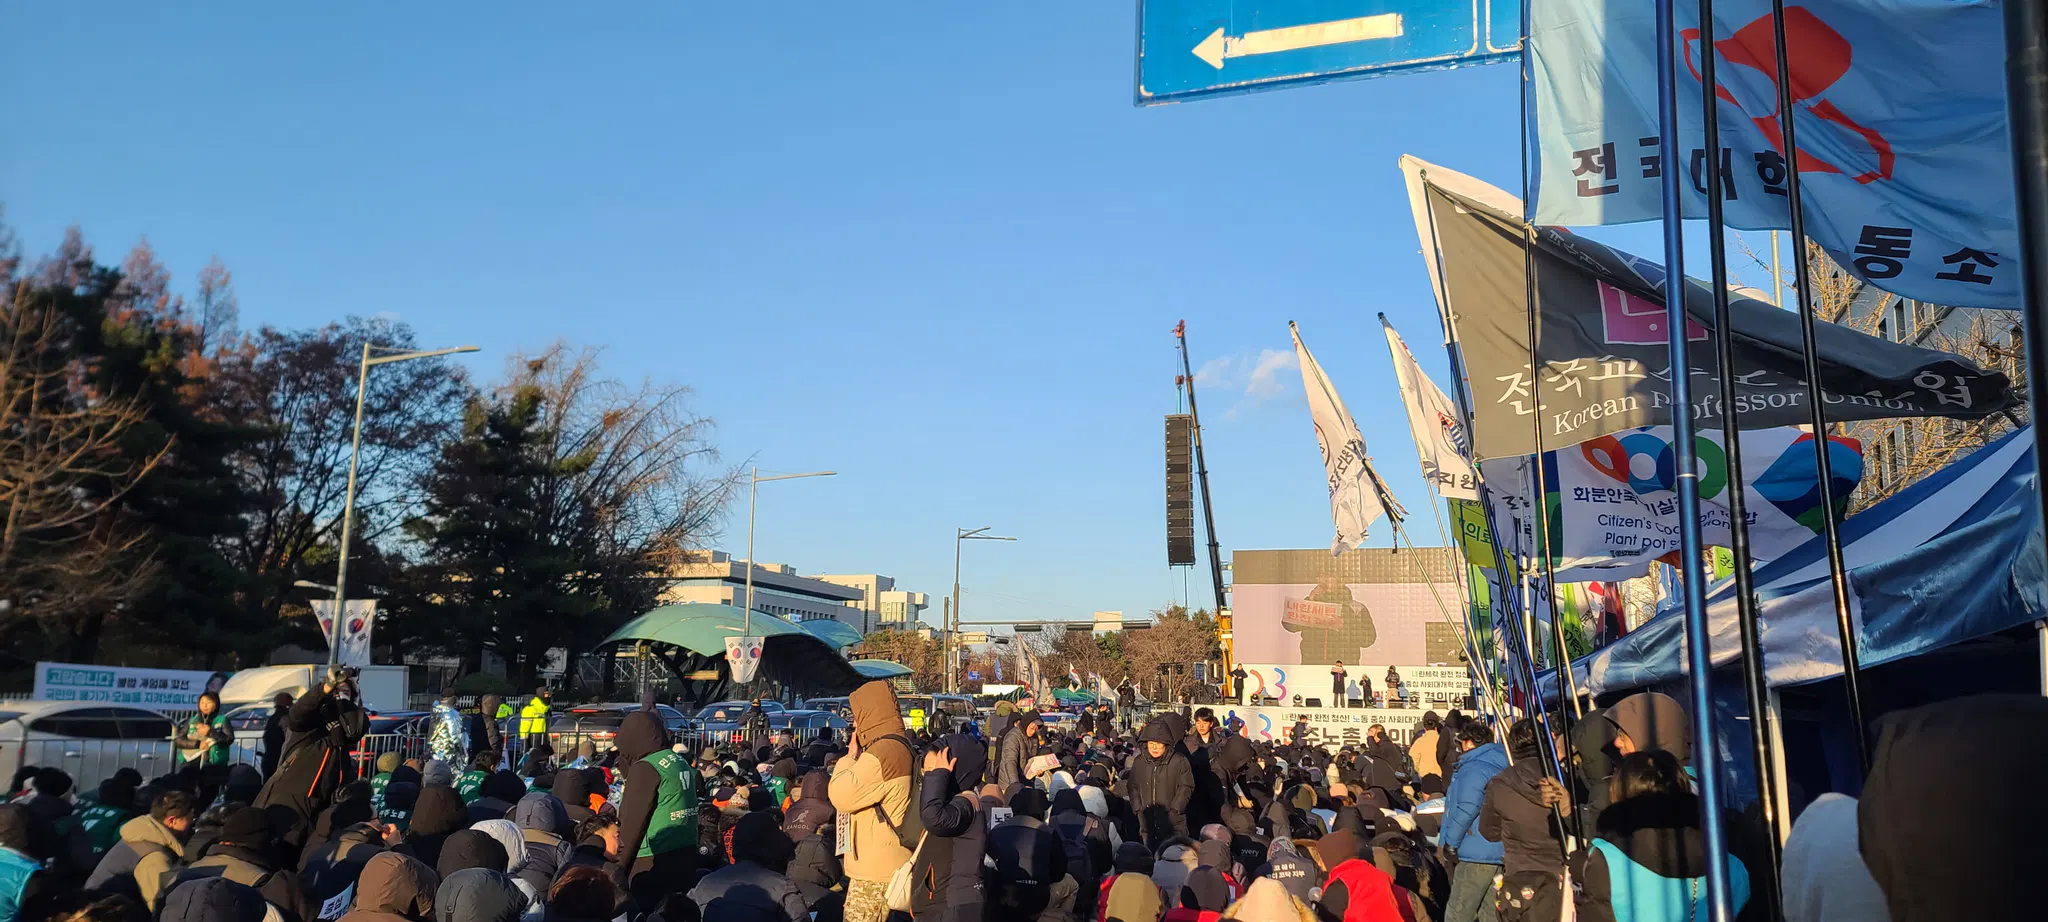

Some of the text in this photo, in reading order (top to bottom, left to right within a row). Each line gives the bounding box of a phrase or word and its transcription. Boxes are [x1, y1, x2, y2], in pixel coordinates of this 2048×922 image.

[1553, 394, 1639, 436] Korean
[1598, 513, 1652, 530] Citizen's
[1605, 532, 1637, 546] Plant
[1642, 535, 1666, 550] pot
[1314, 714, 1330, 722] 완전
[1353, 715, 1368, 723] 노동
[1388, 716, 1423, 724] 사회대개
